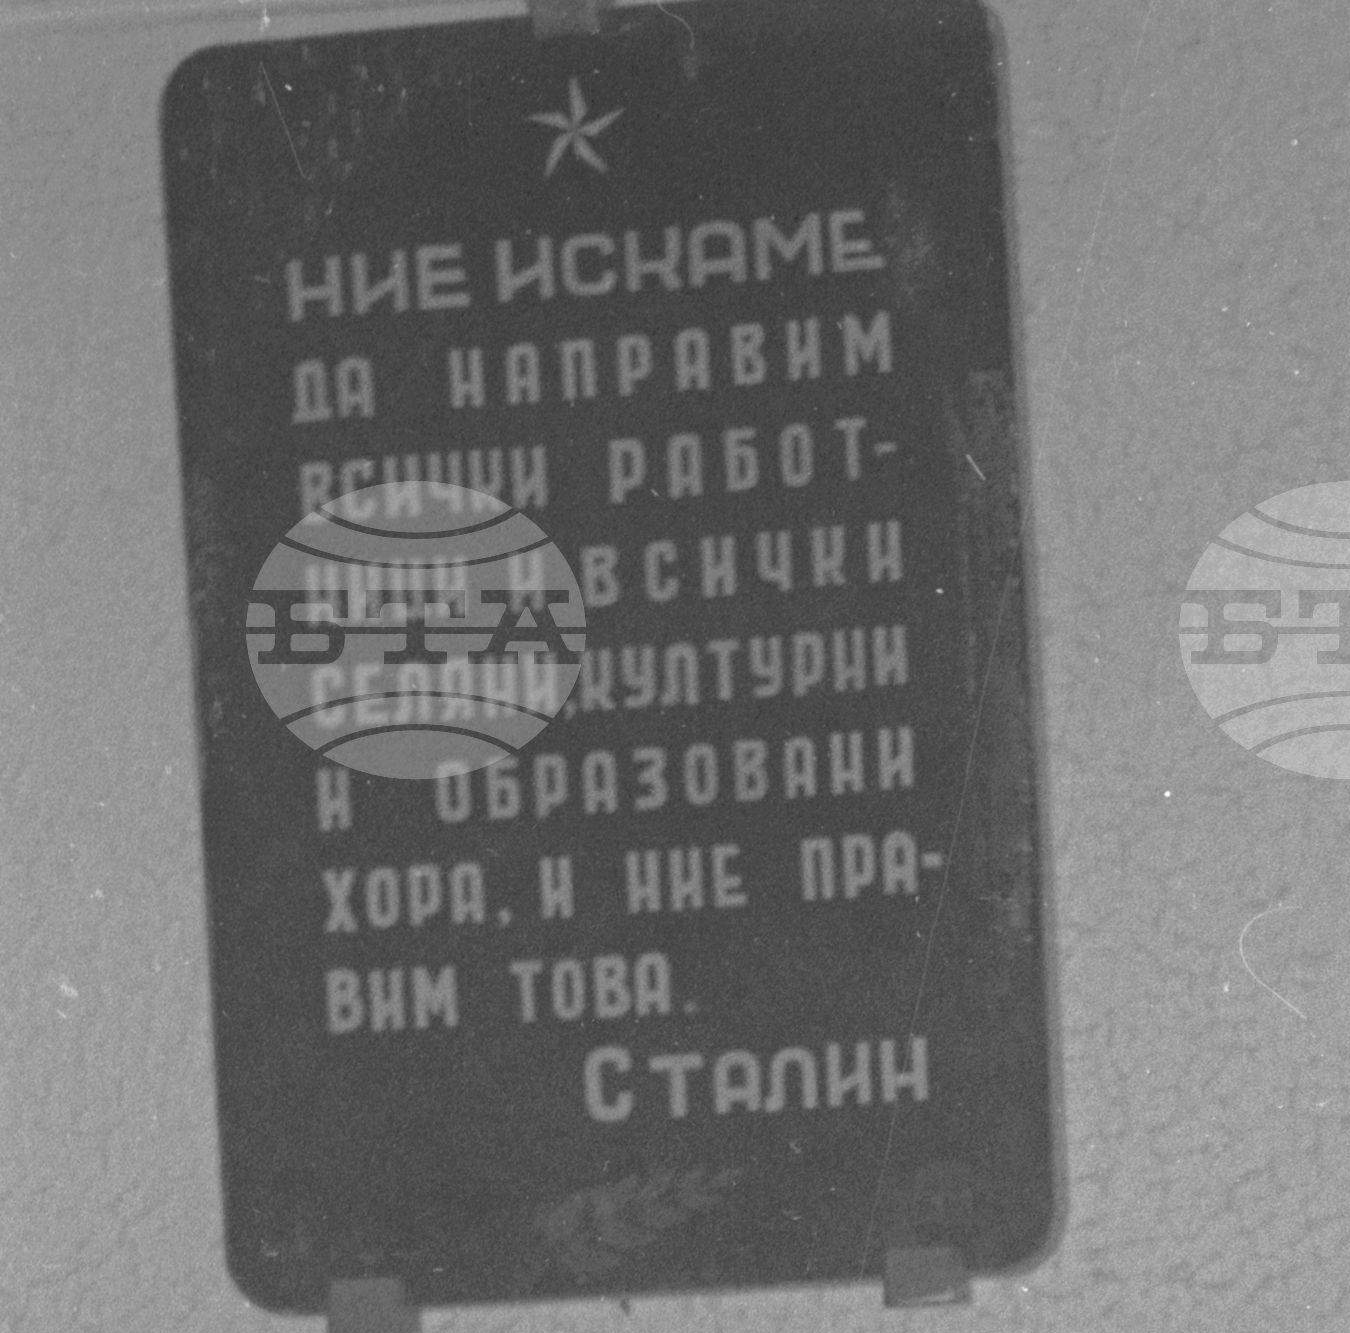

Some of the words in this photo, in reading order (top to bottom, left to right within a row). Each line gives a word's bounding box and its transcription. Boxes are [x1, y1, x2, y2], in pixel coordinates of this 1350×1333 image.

[285, 243, 471, 322] НИЕ
[494, 209, 886, 304] ИСКАМЕ
[291, 357, 376, 424] ДА
[449, 311, 894, 409] НАПРАВИМ
[302, 444, 548, 524] ВСИЧКИ
[609, 416, 898, 503] РАБОТ-
[581, 518, 903, 608] ВСИЧКИ
[582, 625, 909, 713] КУЛТУРНИ
[316, 767, 351, 832] И
[433, 726, 916, 824] ОБРАЗОВАНИ
[538, 856, 575, 920] И
[626, 843, 749, 915] НИЕ
[801, 830, 944, 901] ПРА-
[326, 963, 460, 1035] ВИМ
[582, 1035, 931, 1122] СТАЛИН
